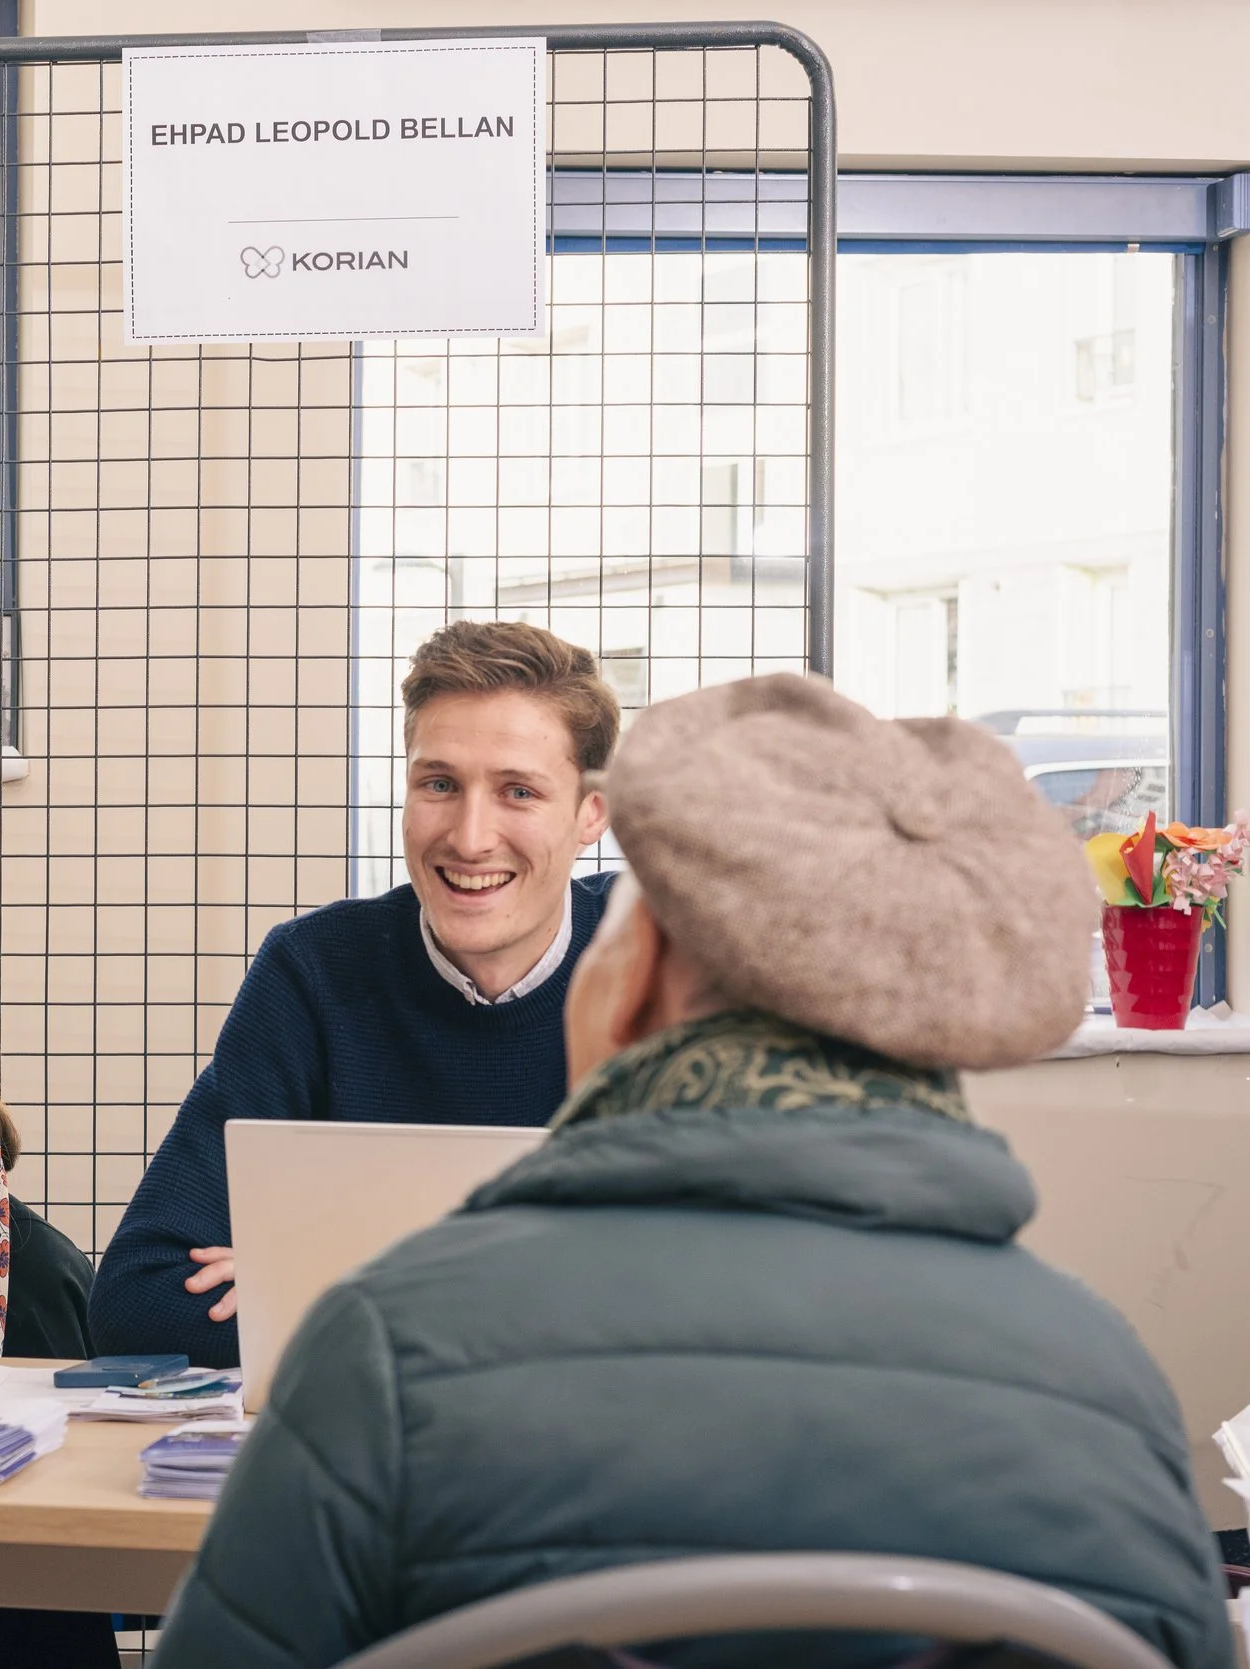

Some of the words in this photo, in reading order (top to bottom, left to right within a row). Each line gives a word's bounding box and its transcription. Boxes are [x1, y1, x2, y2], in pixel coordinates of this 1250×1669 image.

[152, 123, 245, 145] EHPAD
[256, 119, 390, 142] LEOPOLD
[401, 116, 513, 139] BELLAN
[293, 251, 407, 271] KORIAN
